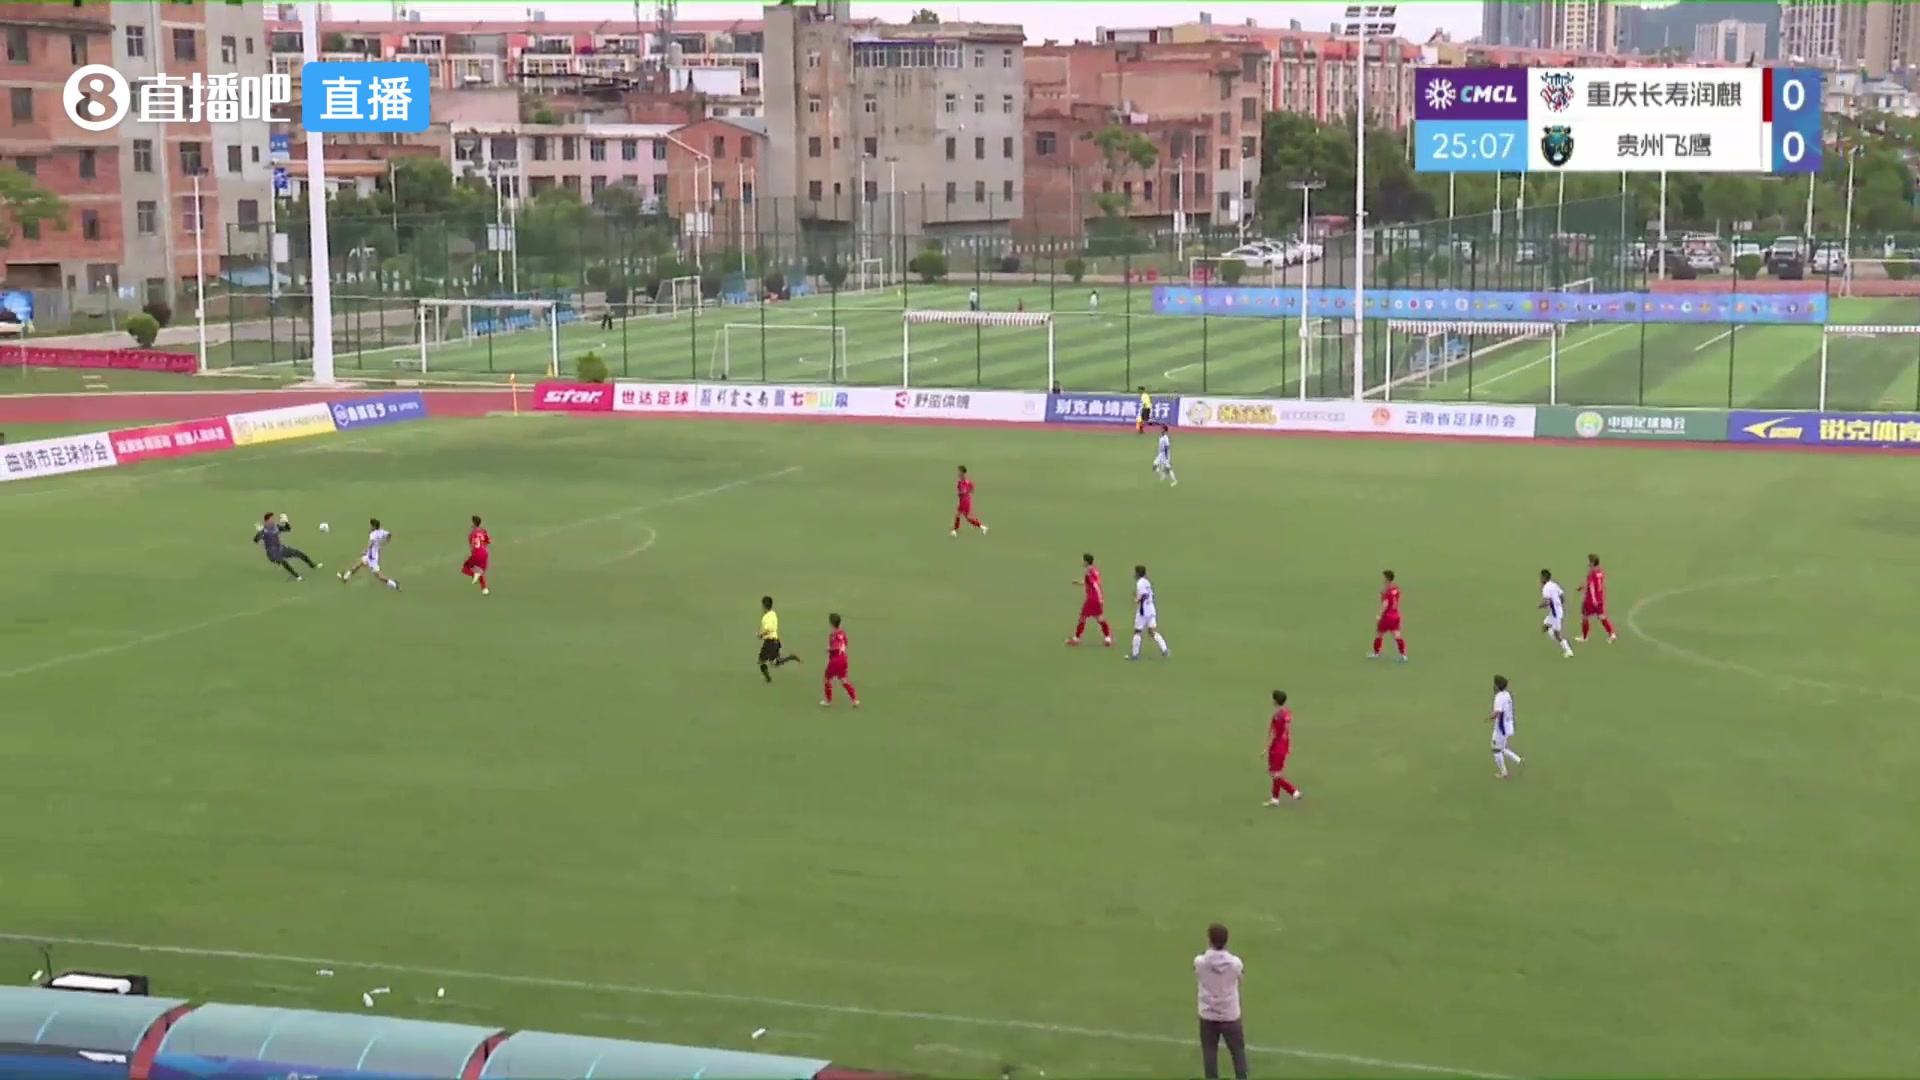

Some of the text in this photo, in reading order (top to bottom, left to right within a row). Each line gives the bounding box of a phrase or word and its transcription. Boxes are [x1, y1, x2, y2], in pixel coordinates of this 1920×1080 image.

[621, 390, 689, 405] 世达足球
[1055, 398, 1171, 419] 别克曲靖燕行
[1405, 410, 1516, 429] 云南省足球协会
[4, 440, 108, 472] 曲靖市足球协会
